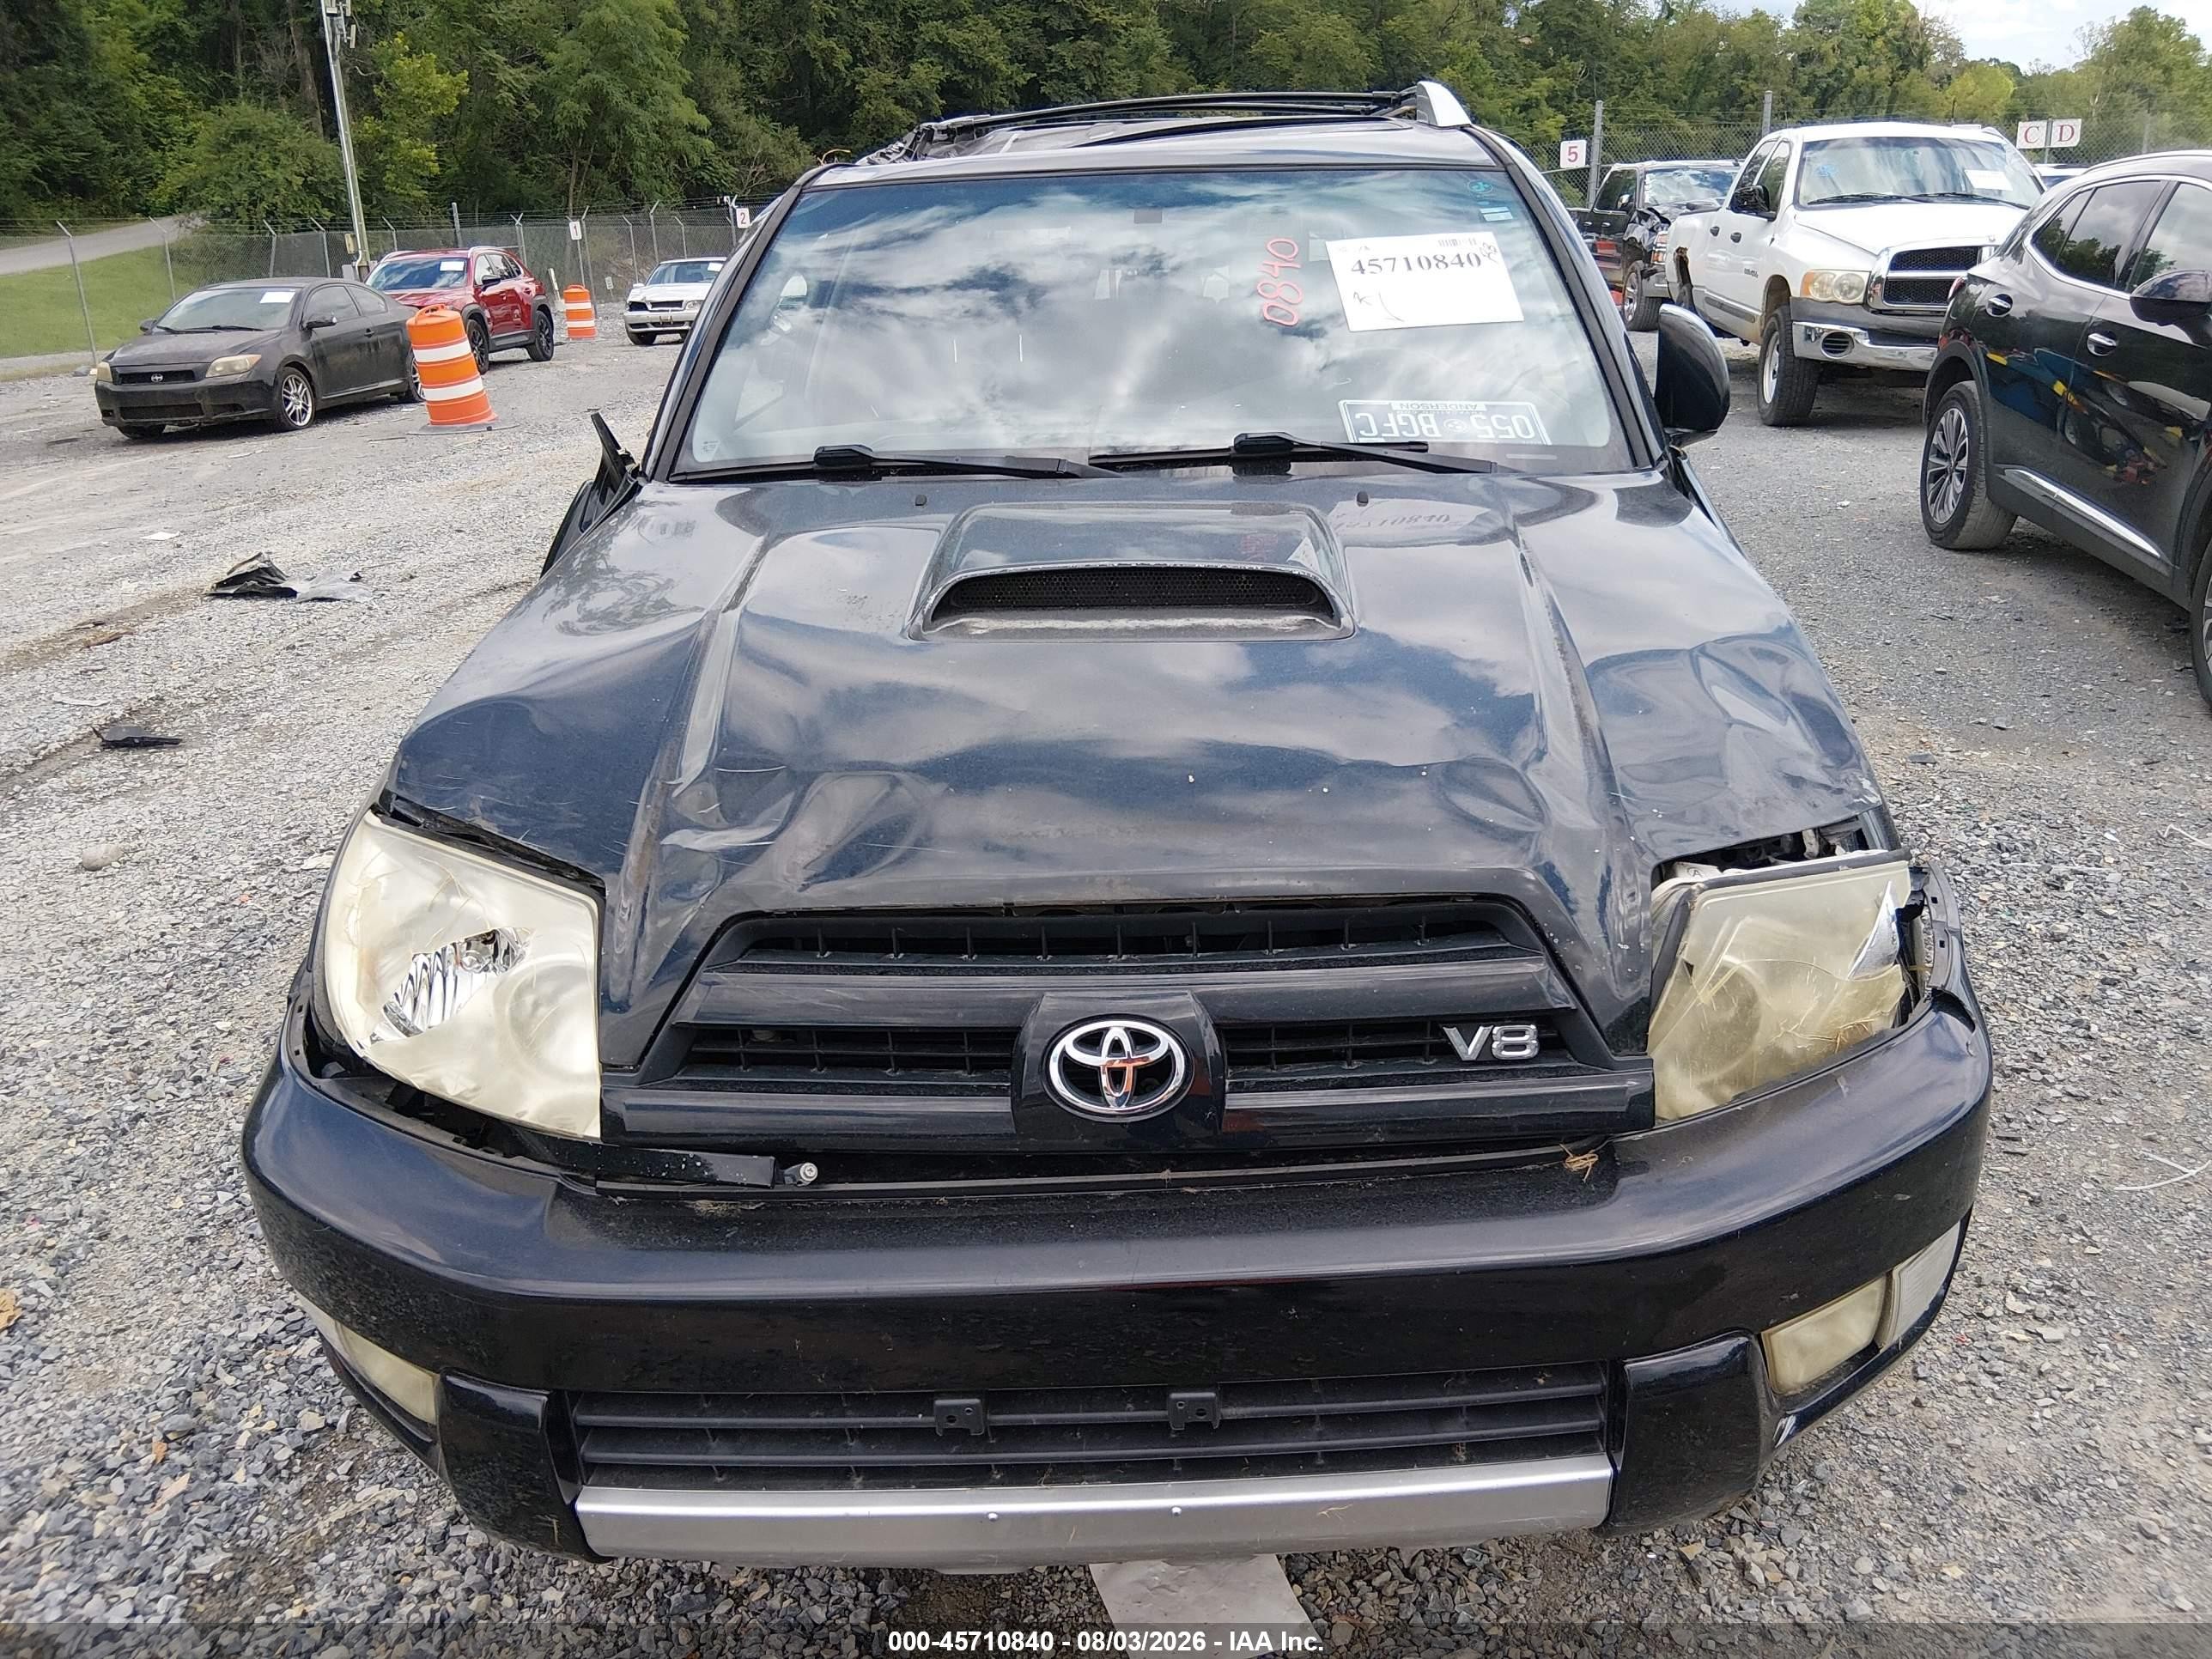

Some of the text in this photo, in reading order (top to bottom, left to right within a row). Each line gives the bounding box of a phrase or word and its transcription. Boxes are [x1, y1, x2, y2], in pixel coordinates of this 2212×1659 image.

[2024, 126, 2039, 143] C
[2057, 125, 2075, 142] D
[1568, 146, 1578, 162] 5
[740, 212, 746, 224] 2
[1351, 252, 1481, 275] 45710840
[1257, 238, 1302, 326] 0840
[1355, 412, 1536, 439] 055 BGFC
[1443, 1024, 1540, 1061] V8
